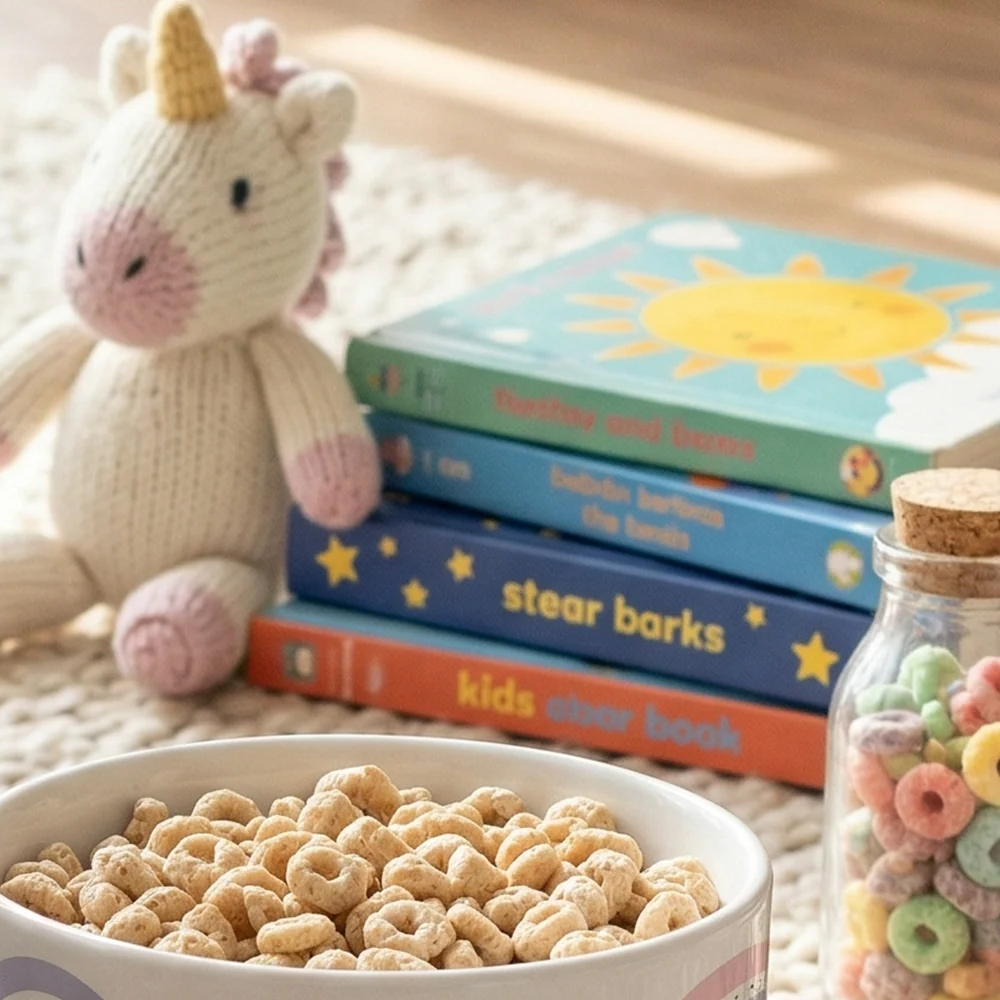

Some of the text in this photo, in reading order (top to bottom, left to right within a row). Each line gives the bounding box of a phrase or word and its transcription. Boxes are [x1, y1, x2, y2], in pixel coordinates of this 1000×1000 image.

[503, 580, 725, 653] stear barks
[457, 669, 536, 718] kids
